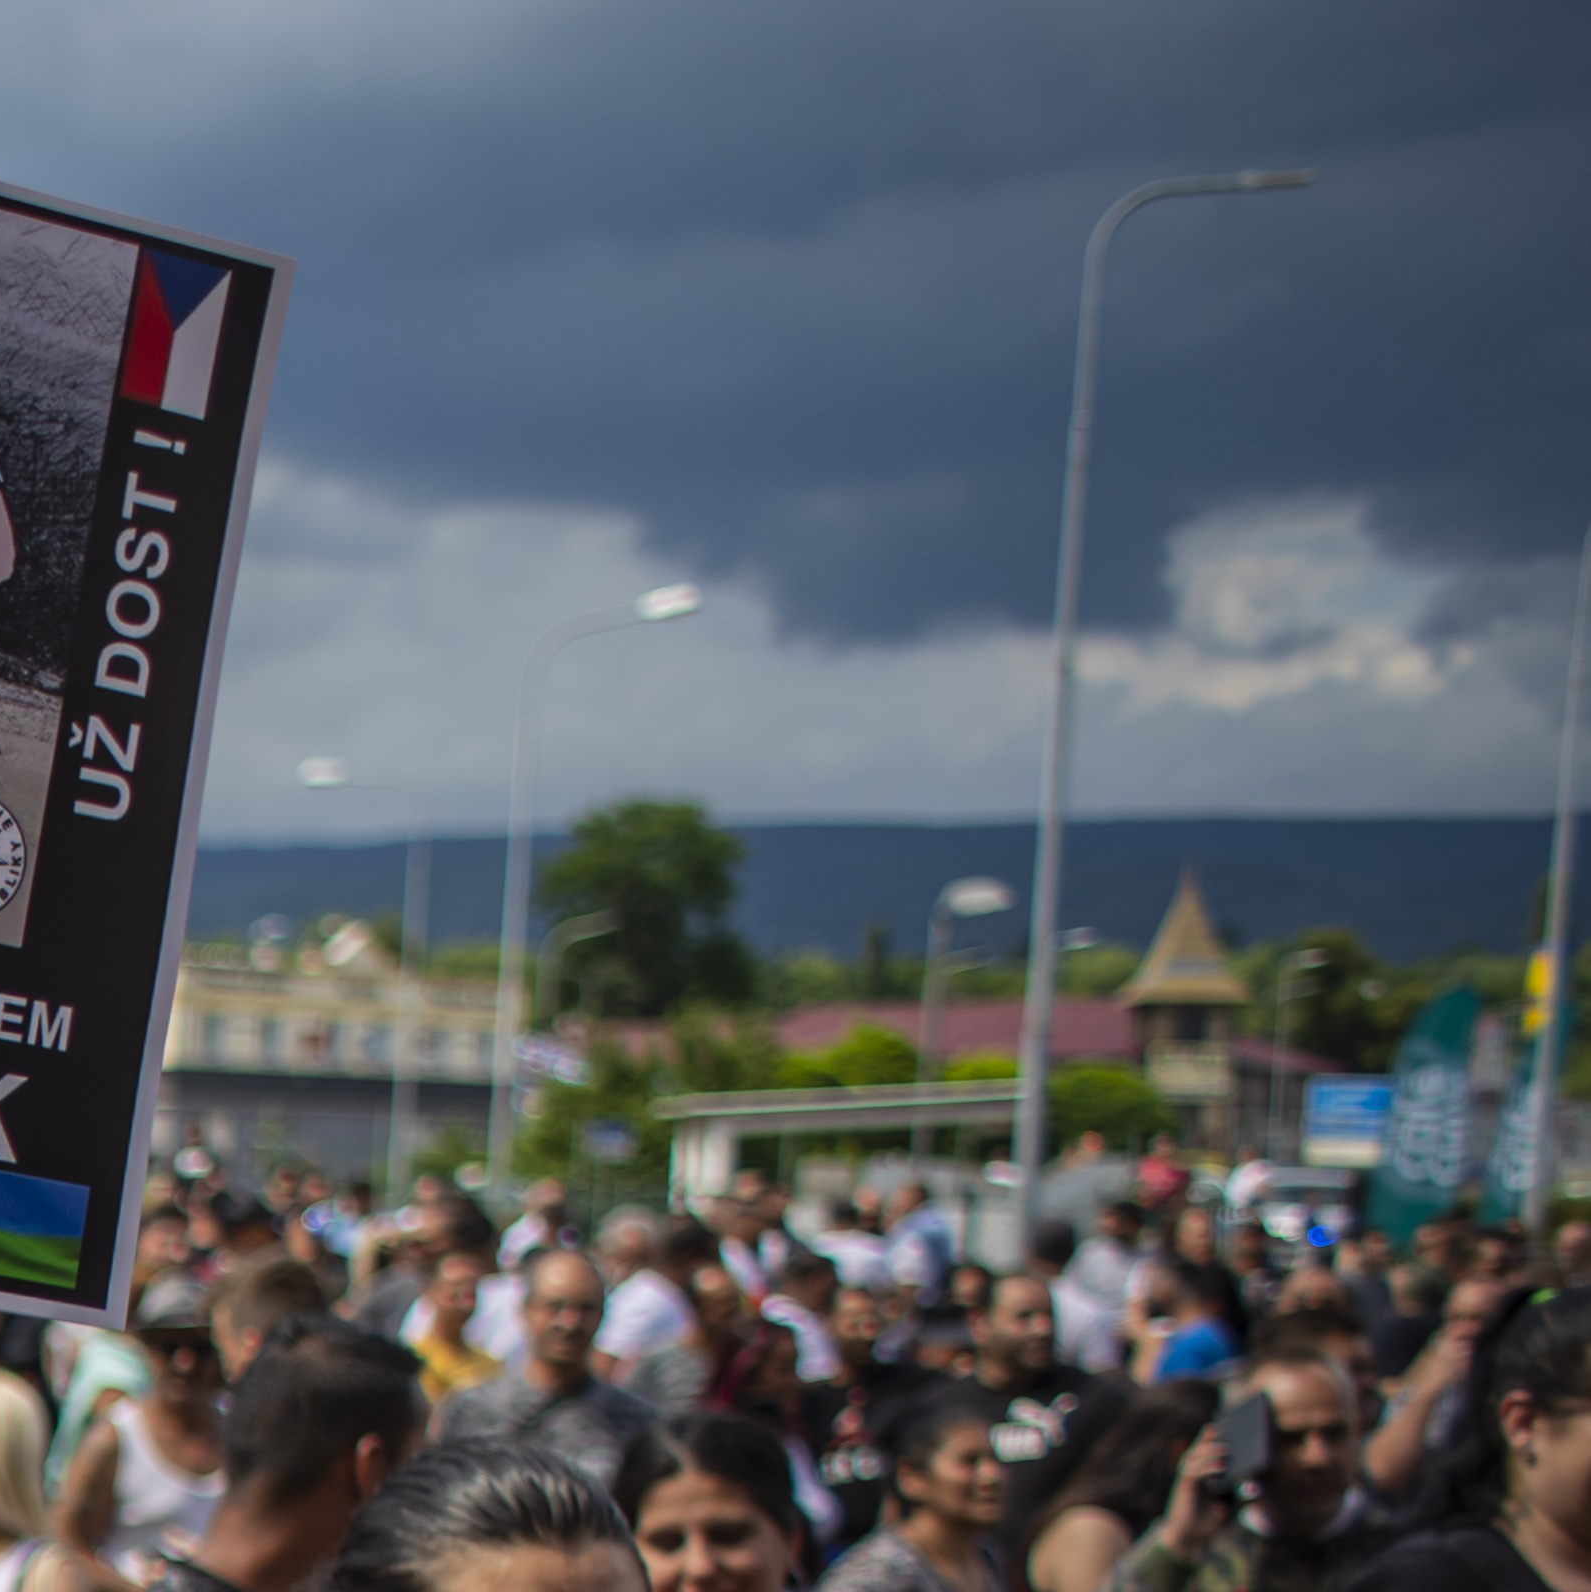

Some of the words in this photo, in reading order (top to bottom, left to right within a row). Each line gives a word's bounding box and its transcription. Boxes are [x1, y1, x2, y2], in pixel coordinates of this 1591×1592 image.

[135, 430, 186, 454] !
[96, 471, 176, 697] DOST
[69, 715, 141, 820] UŽ
